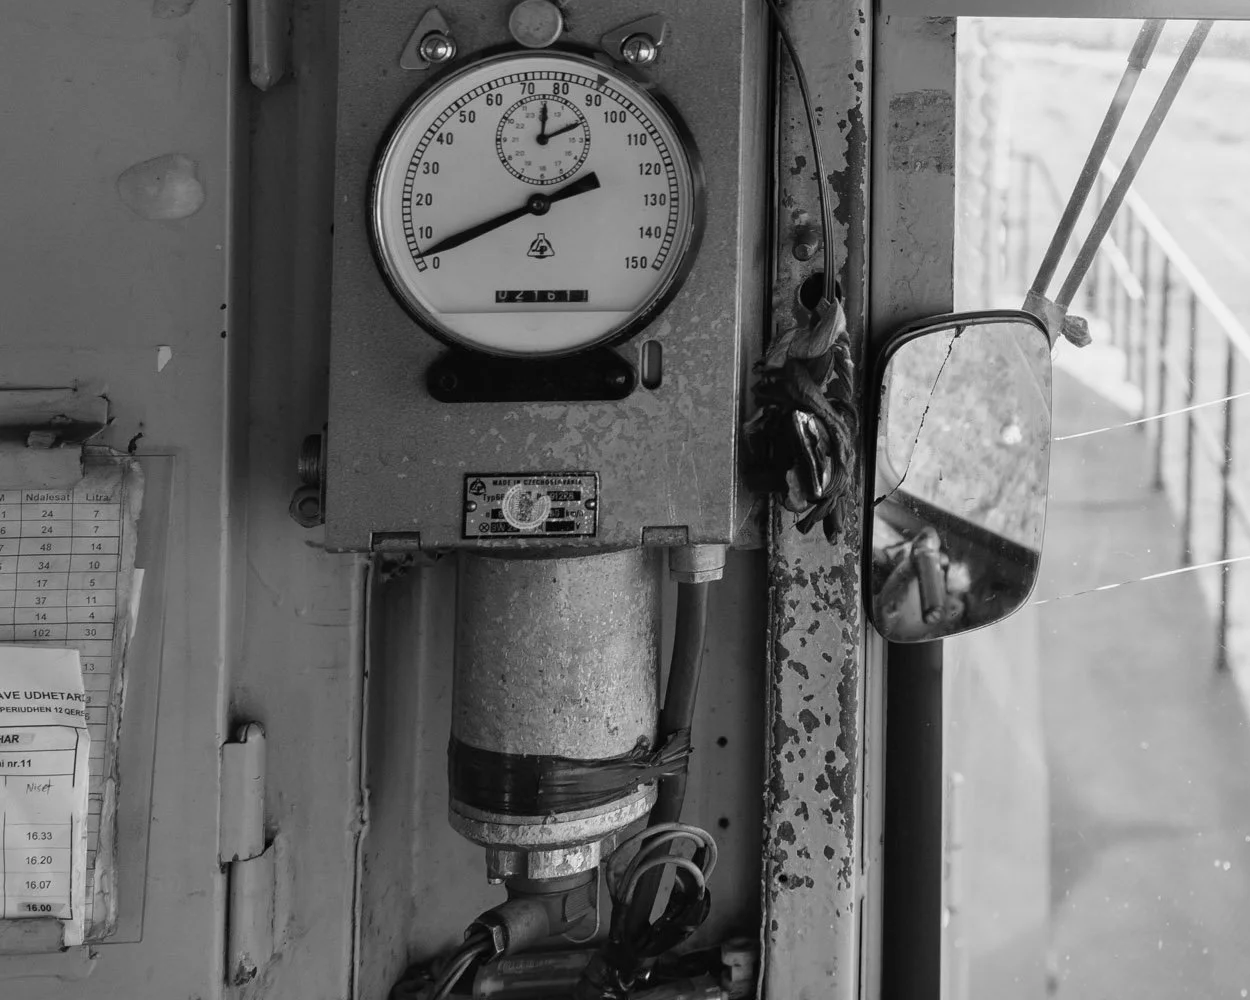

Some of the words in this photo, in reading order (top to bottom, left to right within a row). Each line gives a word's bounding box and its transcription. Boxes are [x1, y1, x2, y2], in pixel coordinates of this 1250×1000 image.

[520, 83, 535, 95] 70
[553, 83, 569, 95] 80
[486, 94, 503, 106] 60
[585, 95, 602, 107] 90
[459, 111, 476, 123] 50
[604, 111, 626, 123] 100
[437, 133, 454, 145] 40
[627, 134, 647, 146] 110
[423, 163, 439, 175] 30
[639, 163, 661, 175] 120
[416, 194, 433, 206] 20
[644, 194, 666, 206] 130
[419, 227, 433, 239] 10
[639, 227, 662, 239] 140
[432, 257, 440, 269] 0
[625, 257, 647, 269] 150
[26, 493, 70, 501] Ndalesat
[42, 510, 53, 518] 24
[94, 510, 99, 518] 7
[41, 526, 53, 534] 24
[40, 543, 52, 551] 48
[38, 562, 49, 570] 34
[89, 561, 100, 569] 10
[35, 597, 46, 605] 37
[33, 629, 50, 637] 102
[83, 663, 95, 671] 13
[7, 759, 31, 767] nr.11
[26, 832, 52, 840] 16.33
[25, 856, 52, 865] 16.20
[25, 881, 51, 889] 16.07
[26, 904, 52, 912] 16.00
